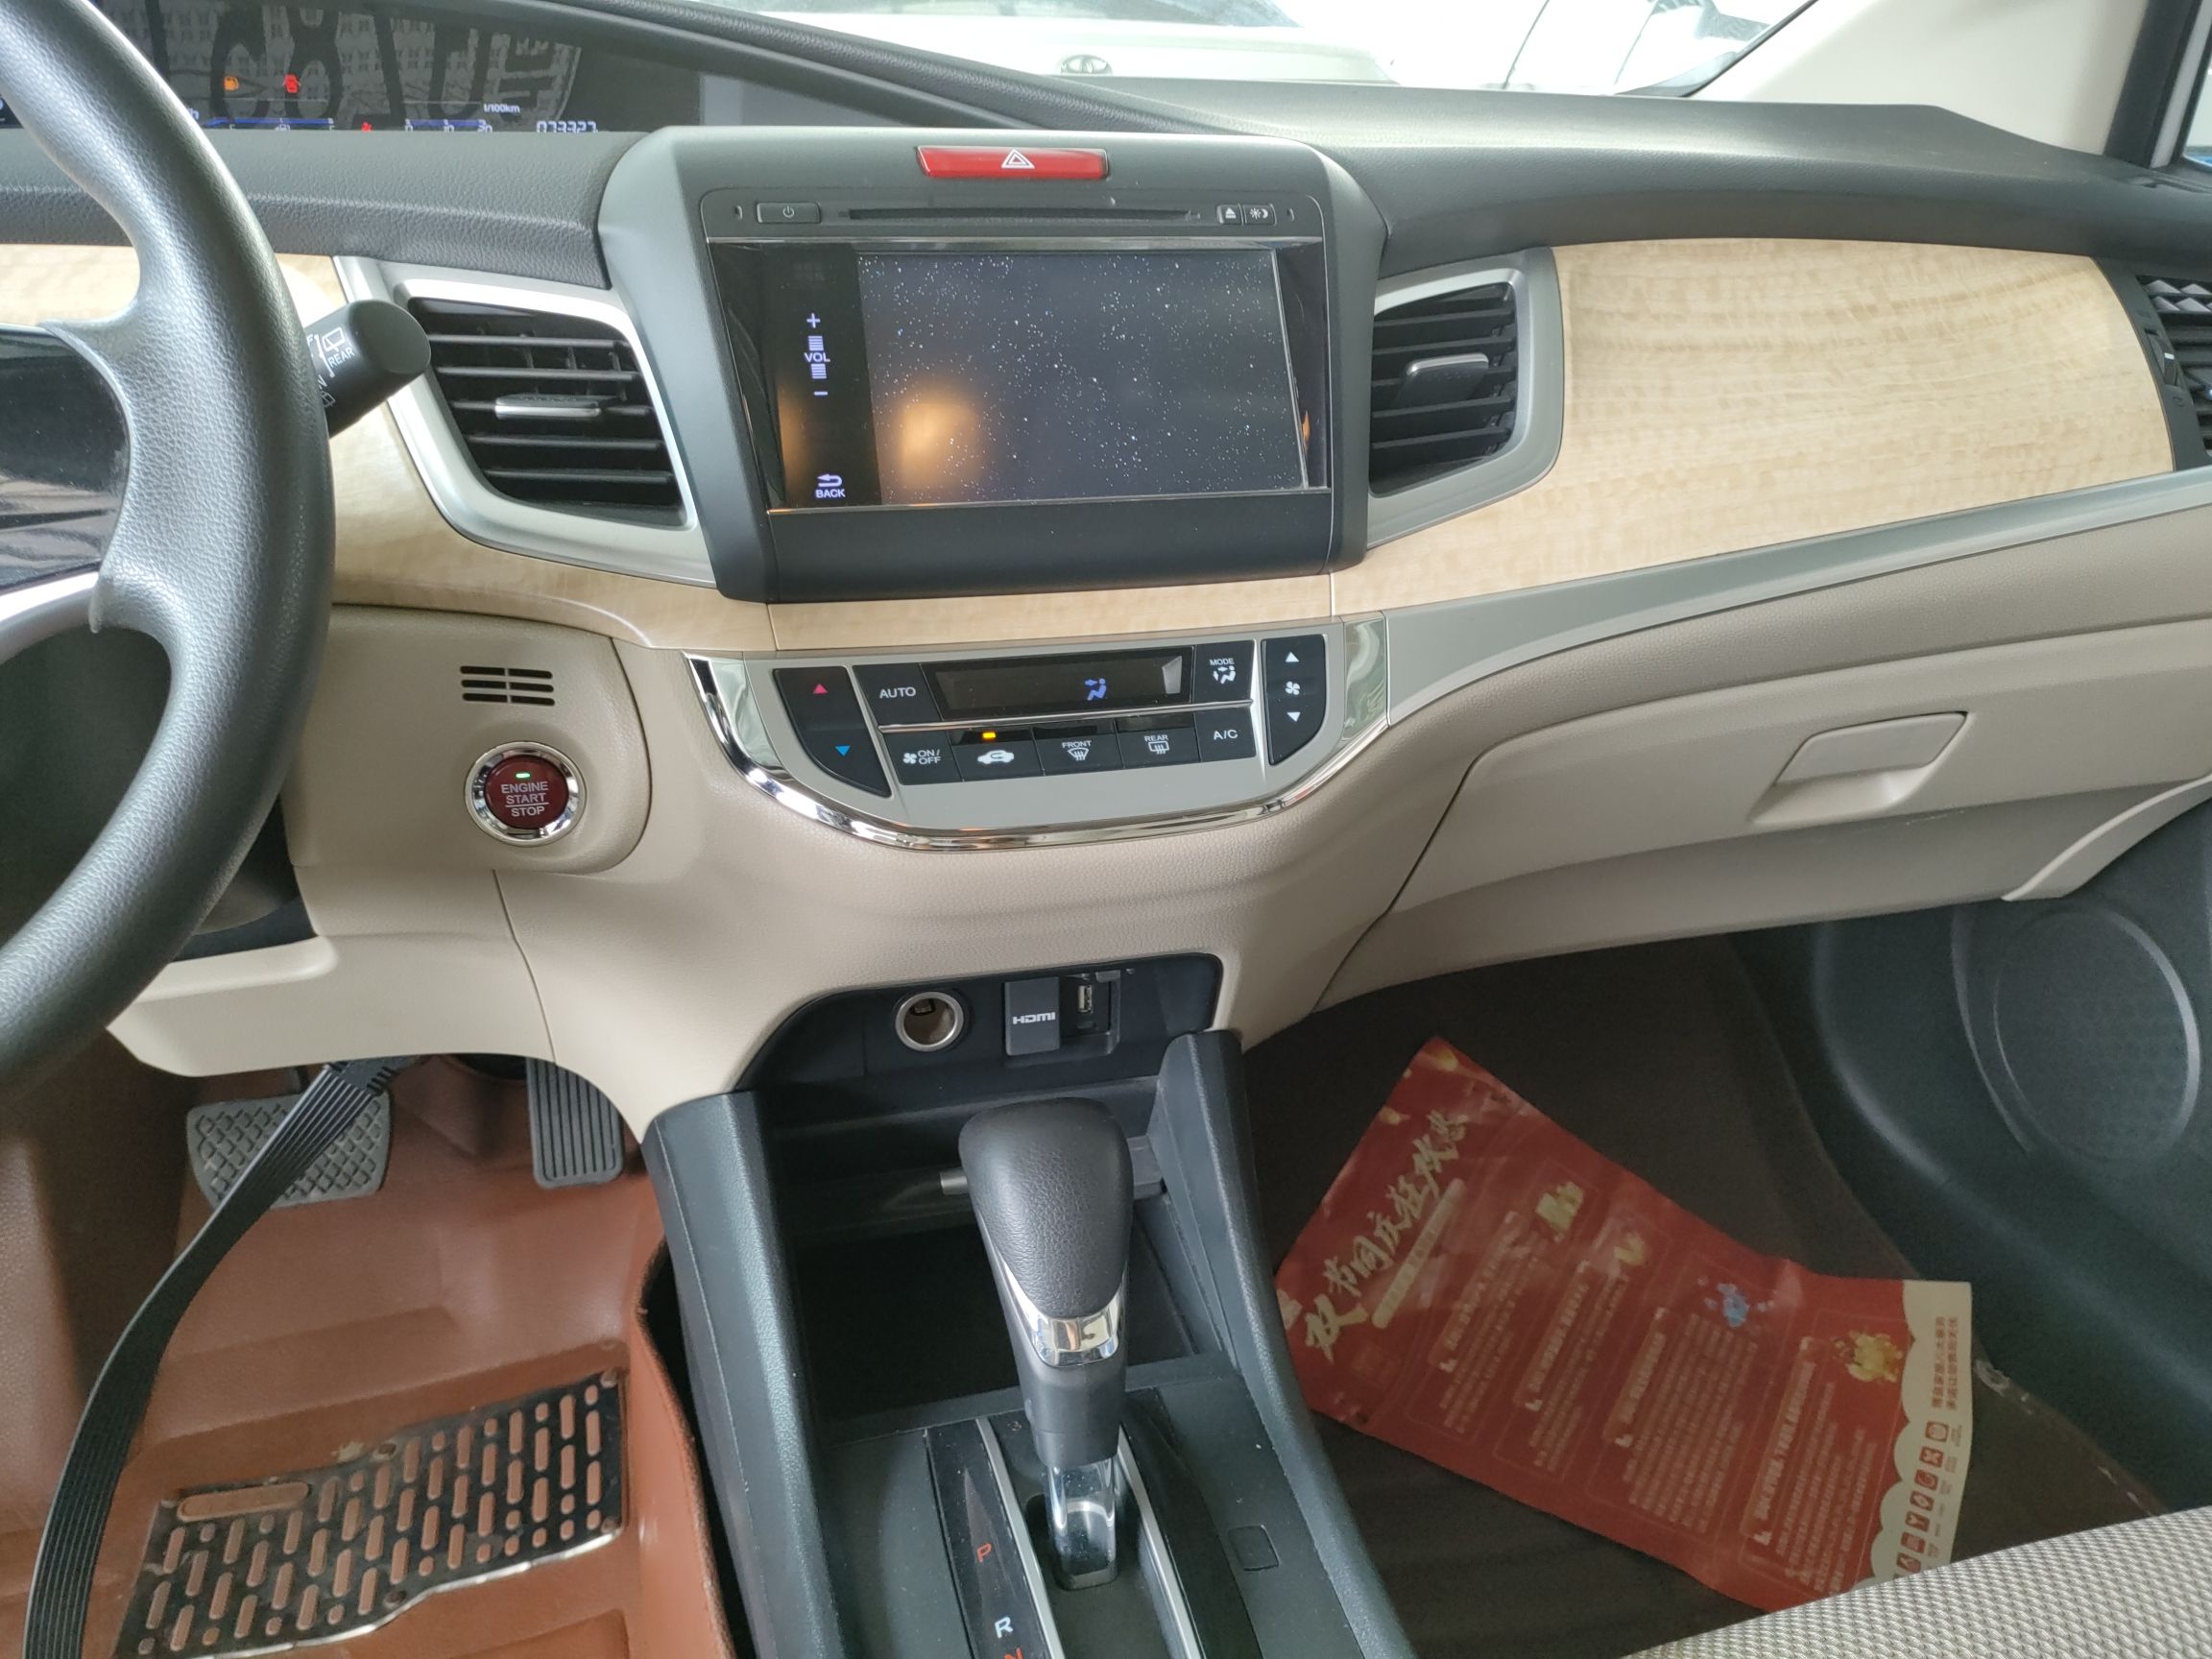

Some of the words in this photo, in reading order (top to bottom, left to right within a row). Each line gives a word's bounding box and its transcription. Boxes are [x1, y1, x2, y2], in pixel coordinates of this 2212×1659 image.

[328, 347, 355, 368] REAR
[805, 352, 830, 363] VOL
[815, 489, 846, 498] BACK
[1209, 658, 1235, 666] MODE
[879, 686, 916, 699] AUTO
[1143, 734, 1168, 743] REAR
[1214, 729, 1238, 740] A/C
[1061, 740, 1092, 749] FRONT
[918, 756, 941, 765] OFF
[501, 781, 548, 793] ENGINE
[506, 793, 545, 805] START
[511, 805, 545, 817] STOP
[1012, 1011, 1056, 1025] HDMI
[976, 1542, 993, 1563] P
[994, 1616, 1014, 1639] R
